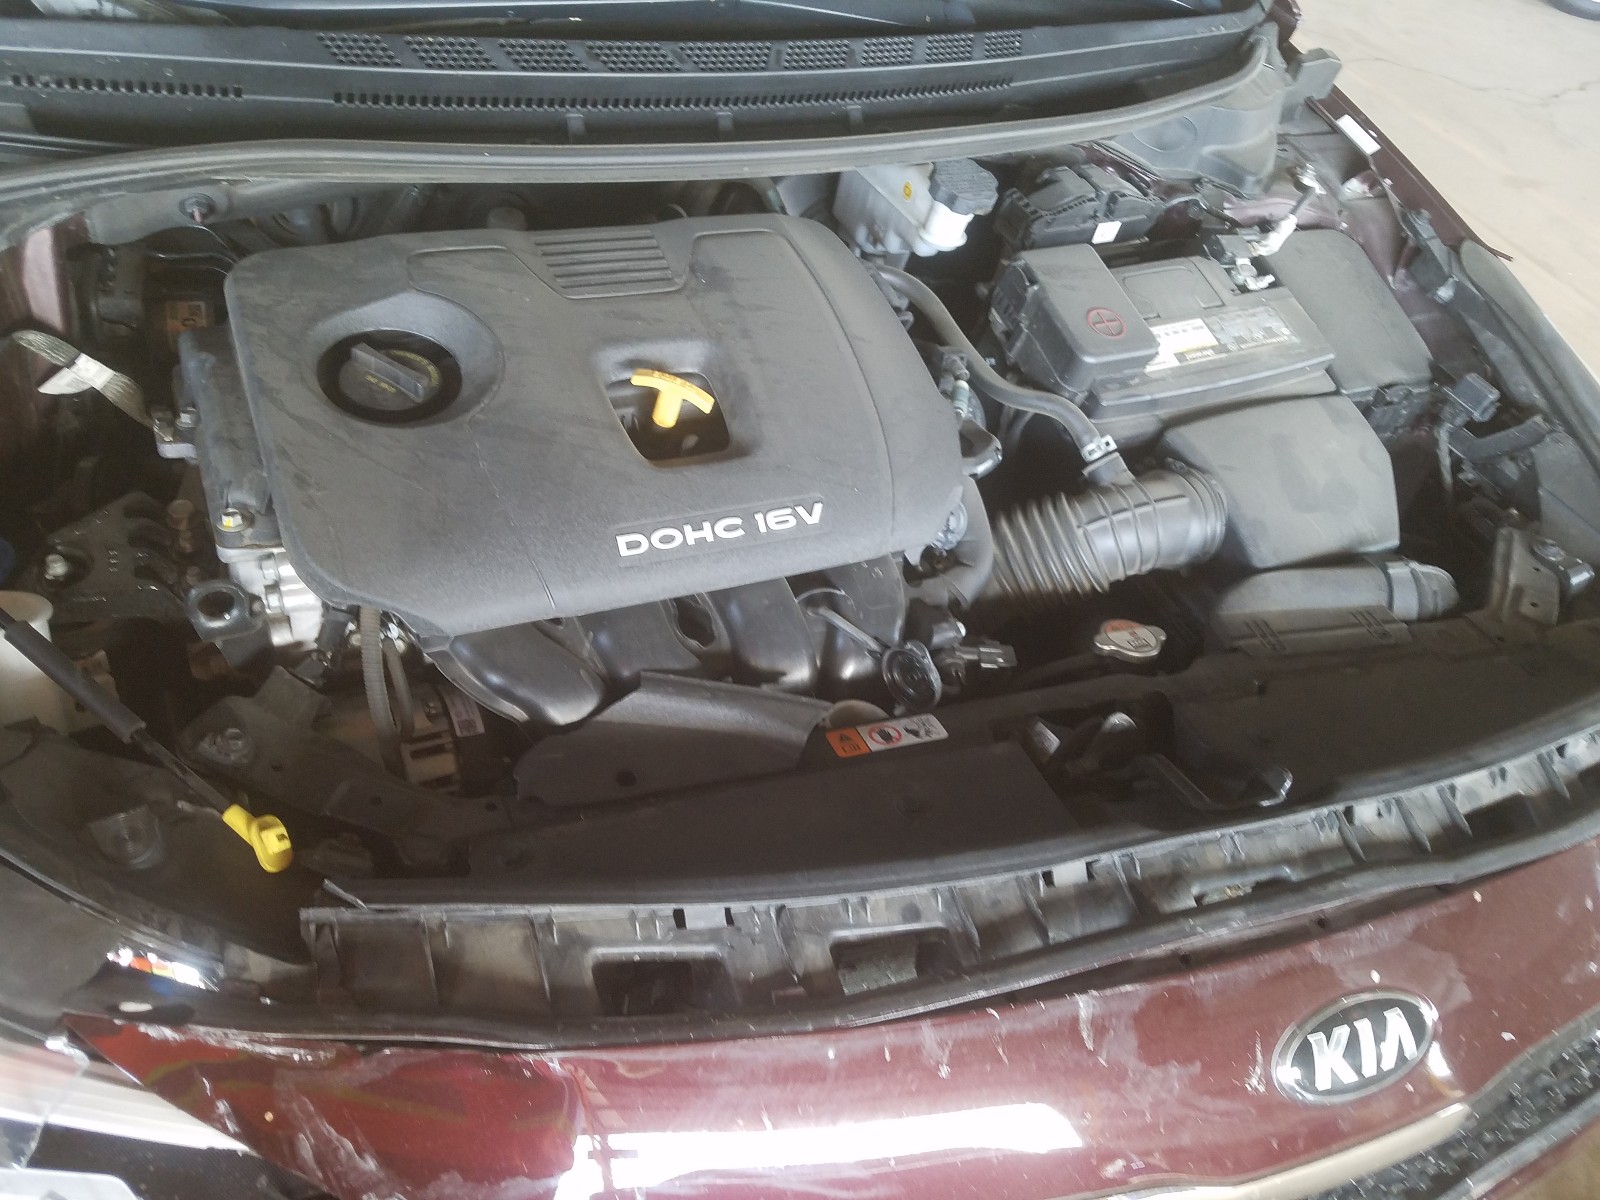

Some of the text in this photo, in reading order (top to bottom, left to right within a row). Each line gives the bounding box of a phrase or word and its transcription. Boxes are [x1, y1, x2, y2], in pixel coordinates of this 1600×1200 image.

[615, 501, 824, 557] DOHC 16V
[1306, 1006, 1418, 1092] KIA
